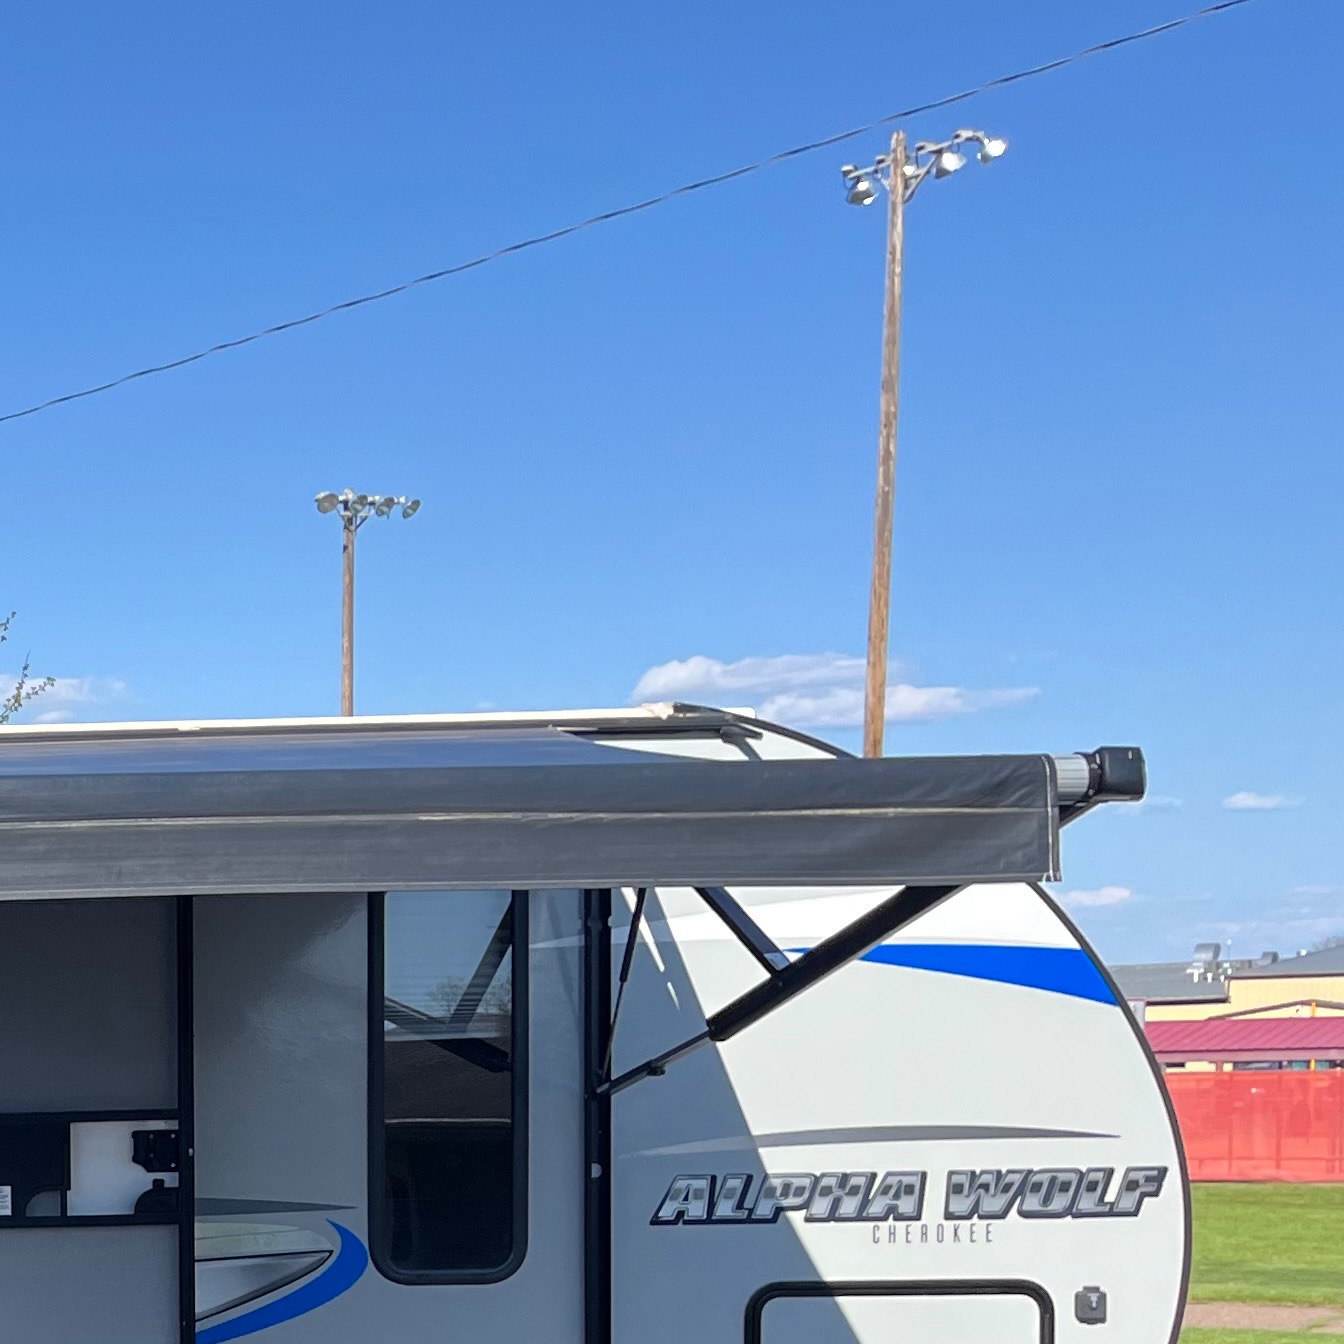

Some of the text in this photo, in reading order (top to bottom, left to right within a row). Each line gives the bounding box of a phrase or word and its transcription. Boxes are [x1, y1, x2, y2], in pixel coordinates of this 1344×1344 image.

[650, 1166, 1168, 1225] ALPHA WOLF
[872, 1223, 994, 1244] CHEROKEE
